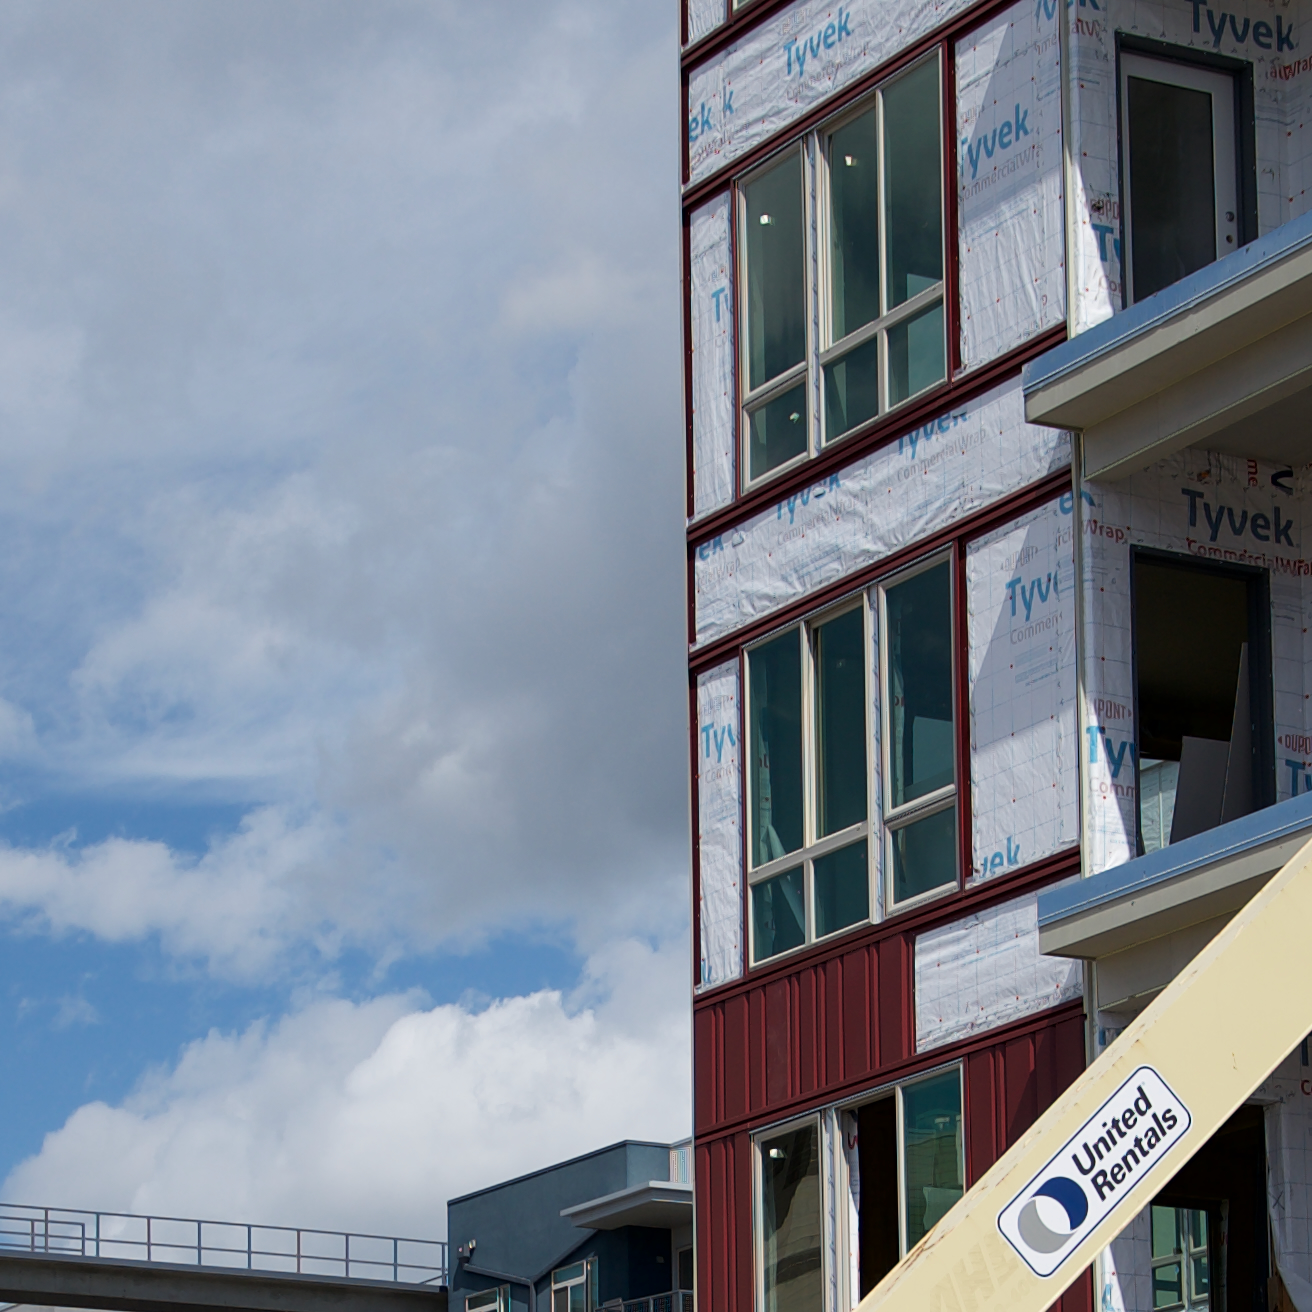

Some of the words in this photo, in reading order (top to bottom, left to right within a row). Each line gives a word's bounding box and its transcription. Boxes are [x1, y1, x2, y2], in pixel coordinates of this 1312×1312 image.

[783, 7, 851, 78] Tyvek
[1184, 0, 1295, 52] Tyvek
[1181, 487, 1295, 548] Tyvek
[1071, 1085, 1153, 1176] United
[1090, 1107, 1178, 1202] Rentals
